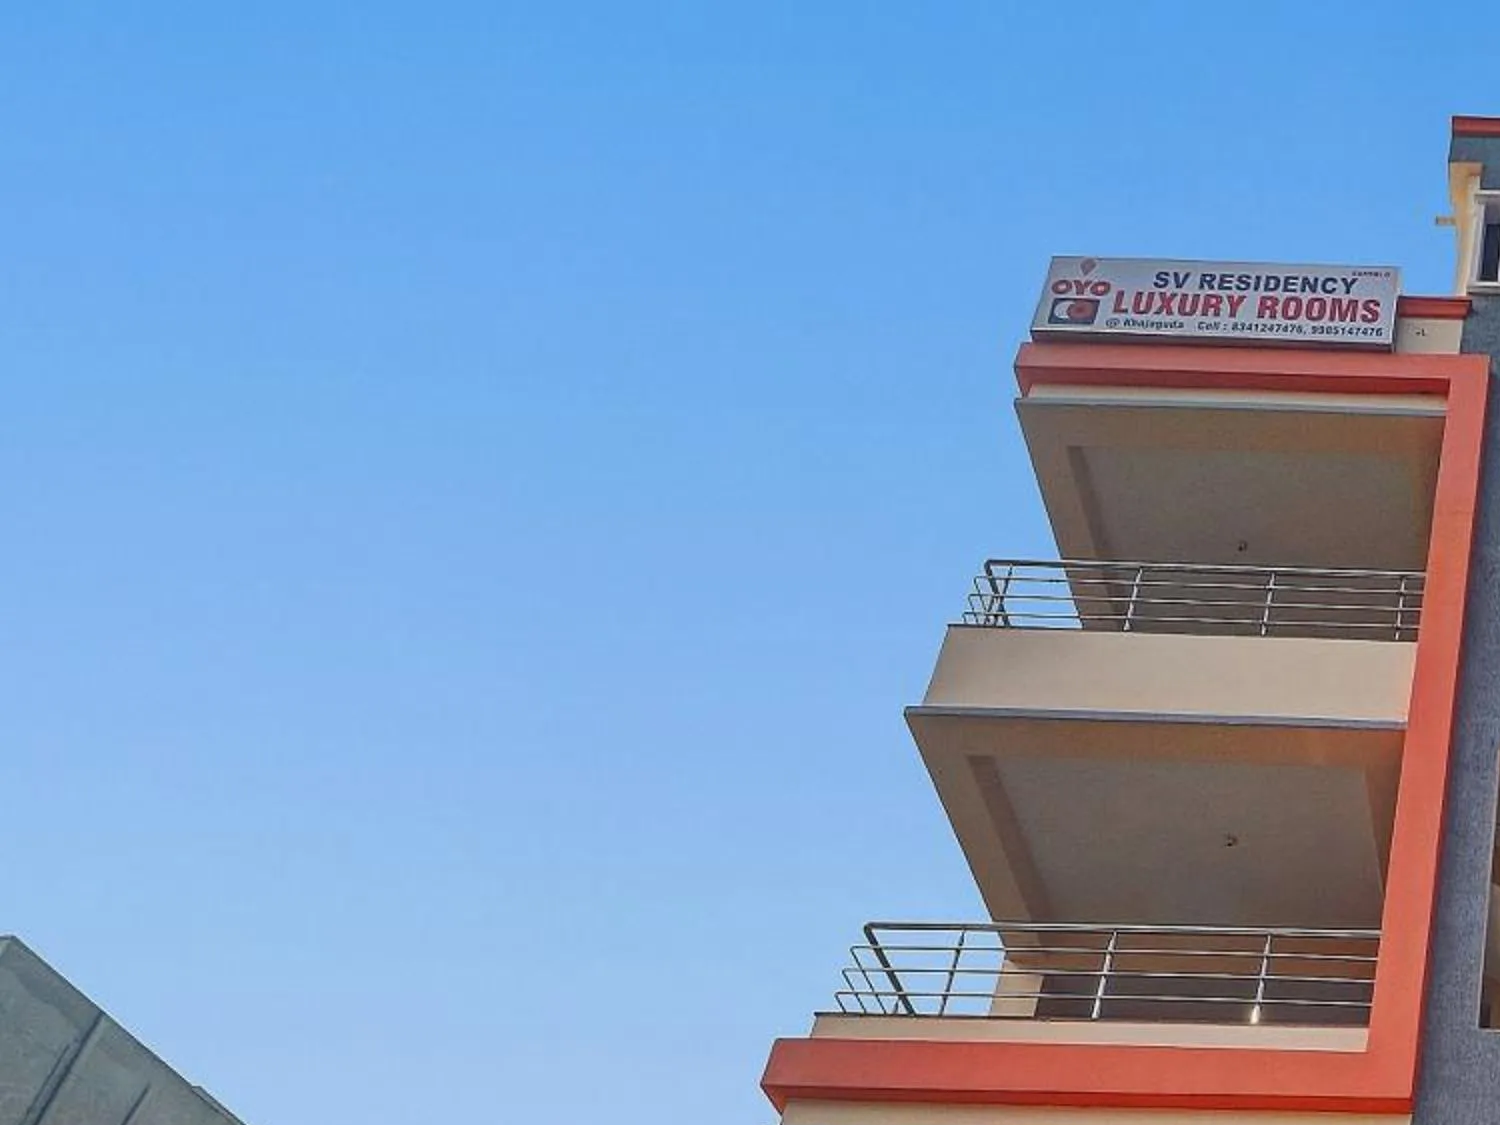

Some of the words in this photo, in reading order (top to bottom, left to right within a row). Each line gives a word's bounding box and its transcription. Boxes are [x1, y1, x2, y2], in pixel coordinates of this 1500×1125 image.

[1051, 279, 1111, 296] OYO
[1153, 271, 1190, 289] SV
[1198, 273, 1358, 294] RESIDENCY
[1112, 290, 1247, 318] LUXURY
[1256, 295, 1381, 324] ROOMS
